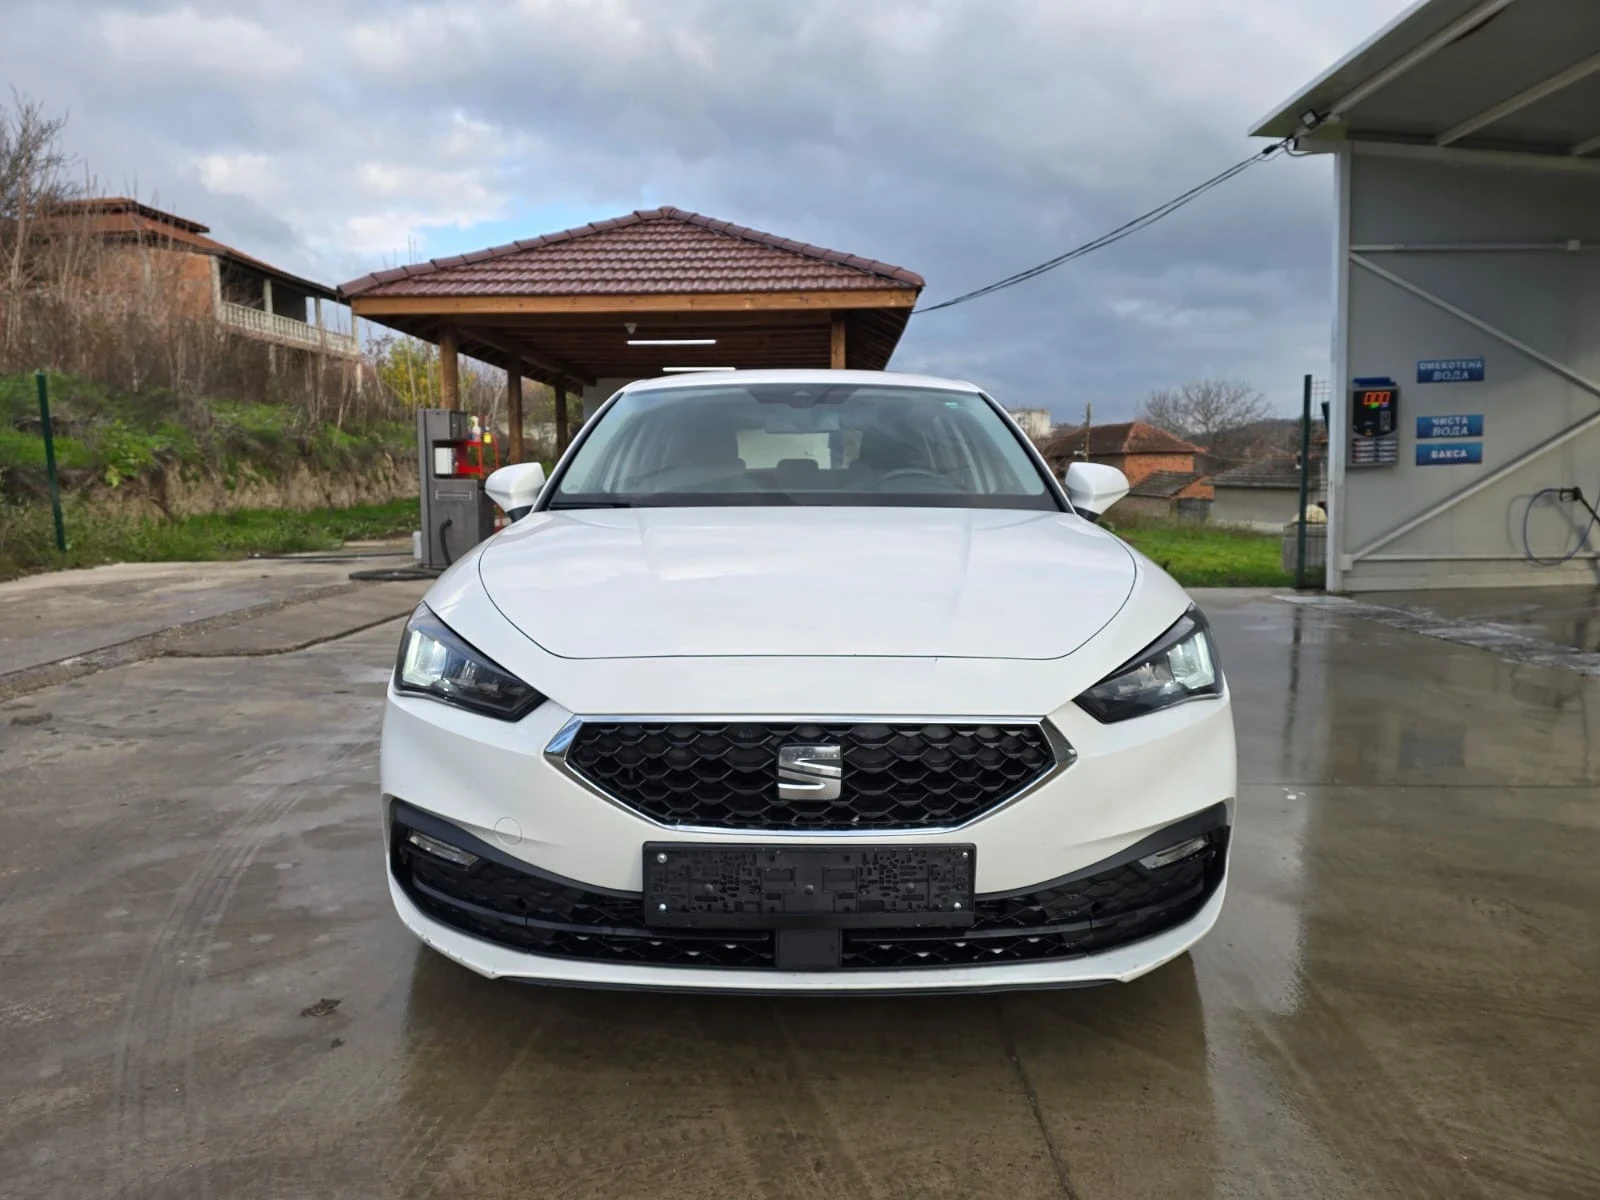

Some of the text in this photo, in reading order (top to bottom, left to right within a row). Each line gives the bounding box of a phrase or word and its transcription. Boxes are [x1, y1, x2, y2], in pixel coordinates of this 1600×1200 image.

[1432, 370, 1469, 380] ВОДА
[1431, 416, 1468, 426] ЧИСТА
[1432, 426, 1468, 436] ВОДА
